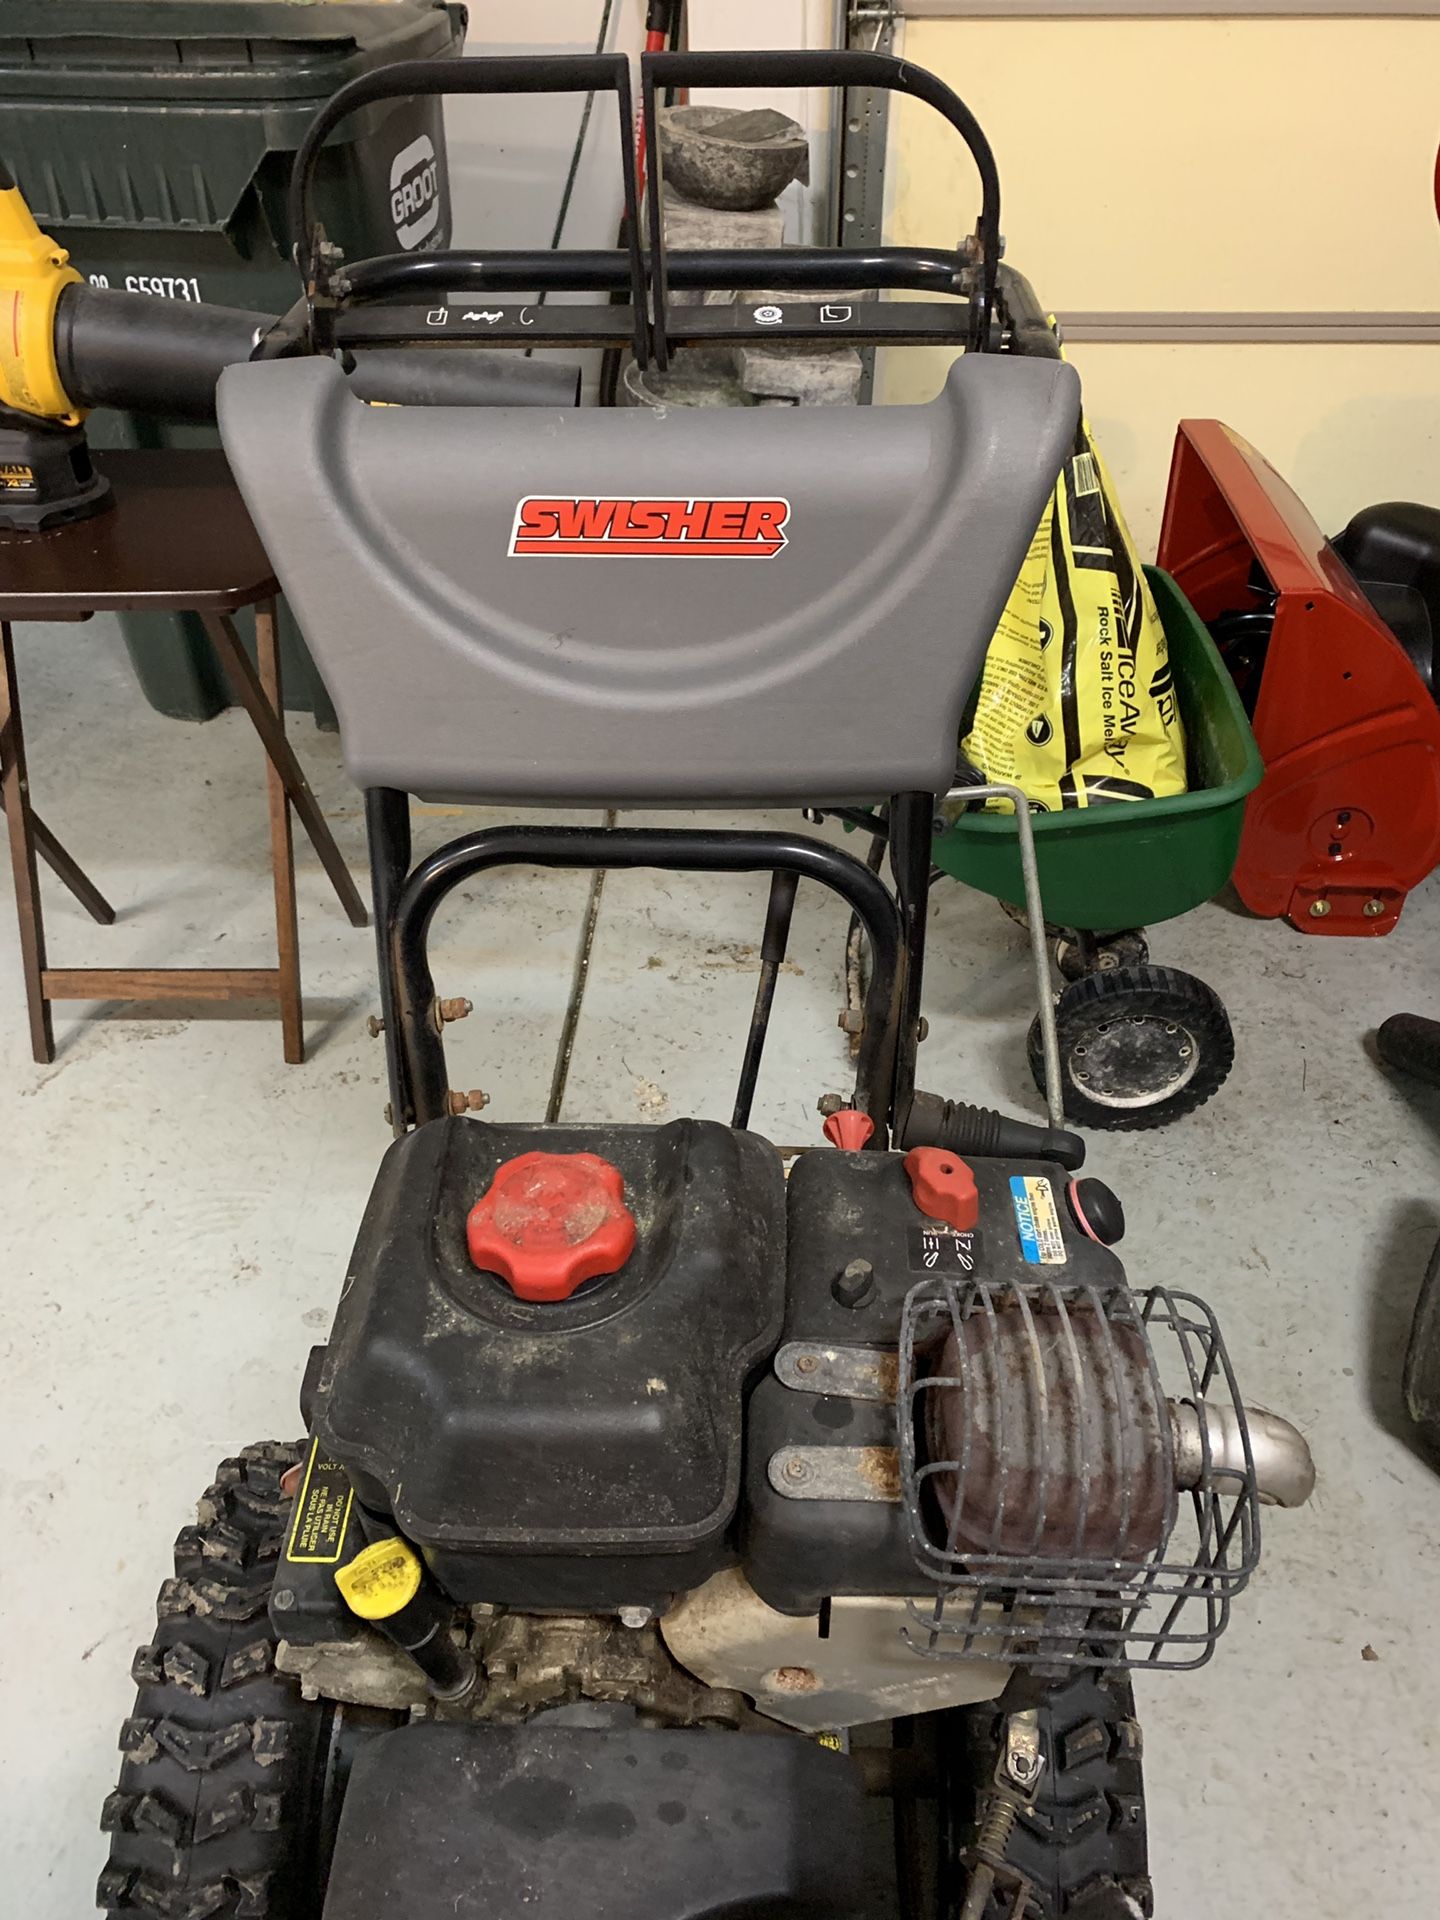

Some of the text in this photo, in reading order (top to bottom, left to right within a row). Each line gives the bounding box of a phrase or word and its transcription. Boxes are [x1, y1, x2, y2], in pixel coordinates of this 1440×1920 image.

[390, 160, 438, 225] GROOT
[125, 275, 201, 304] 659731
[516, 499, 788, 541] SWISHER
[1097, 606, 1116, 745] Rock Salt Ice Mel
[1014, 1195, 1036, 1242] NOTICE
[299, 1488, 320, 1548] SOUS LA PLUIE
[316, 1499, 326, 1514] PAS
[321, 1503, 333, 1534] IN RAIN
[328, 1495, 344, 1543] DO NOT USE
